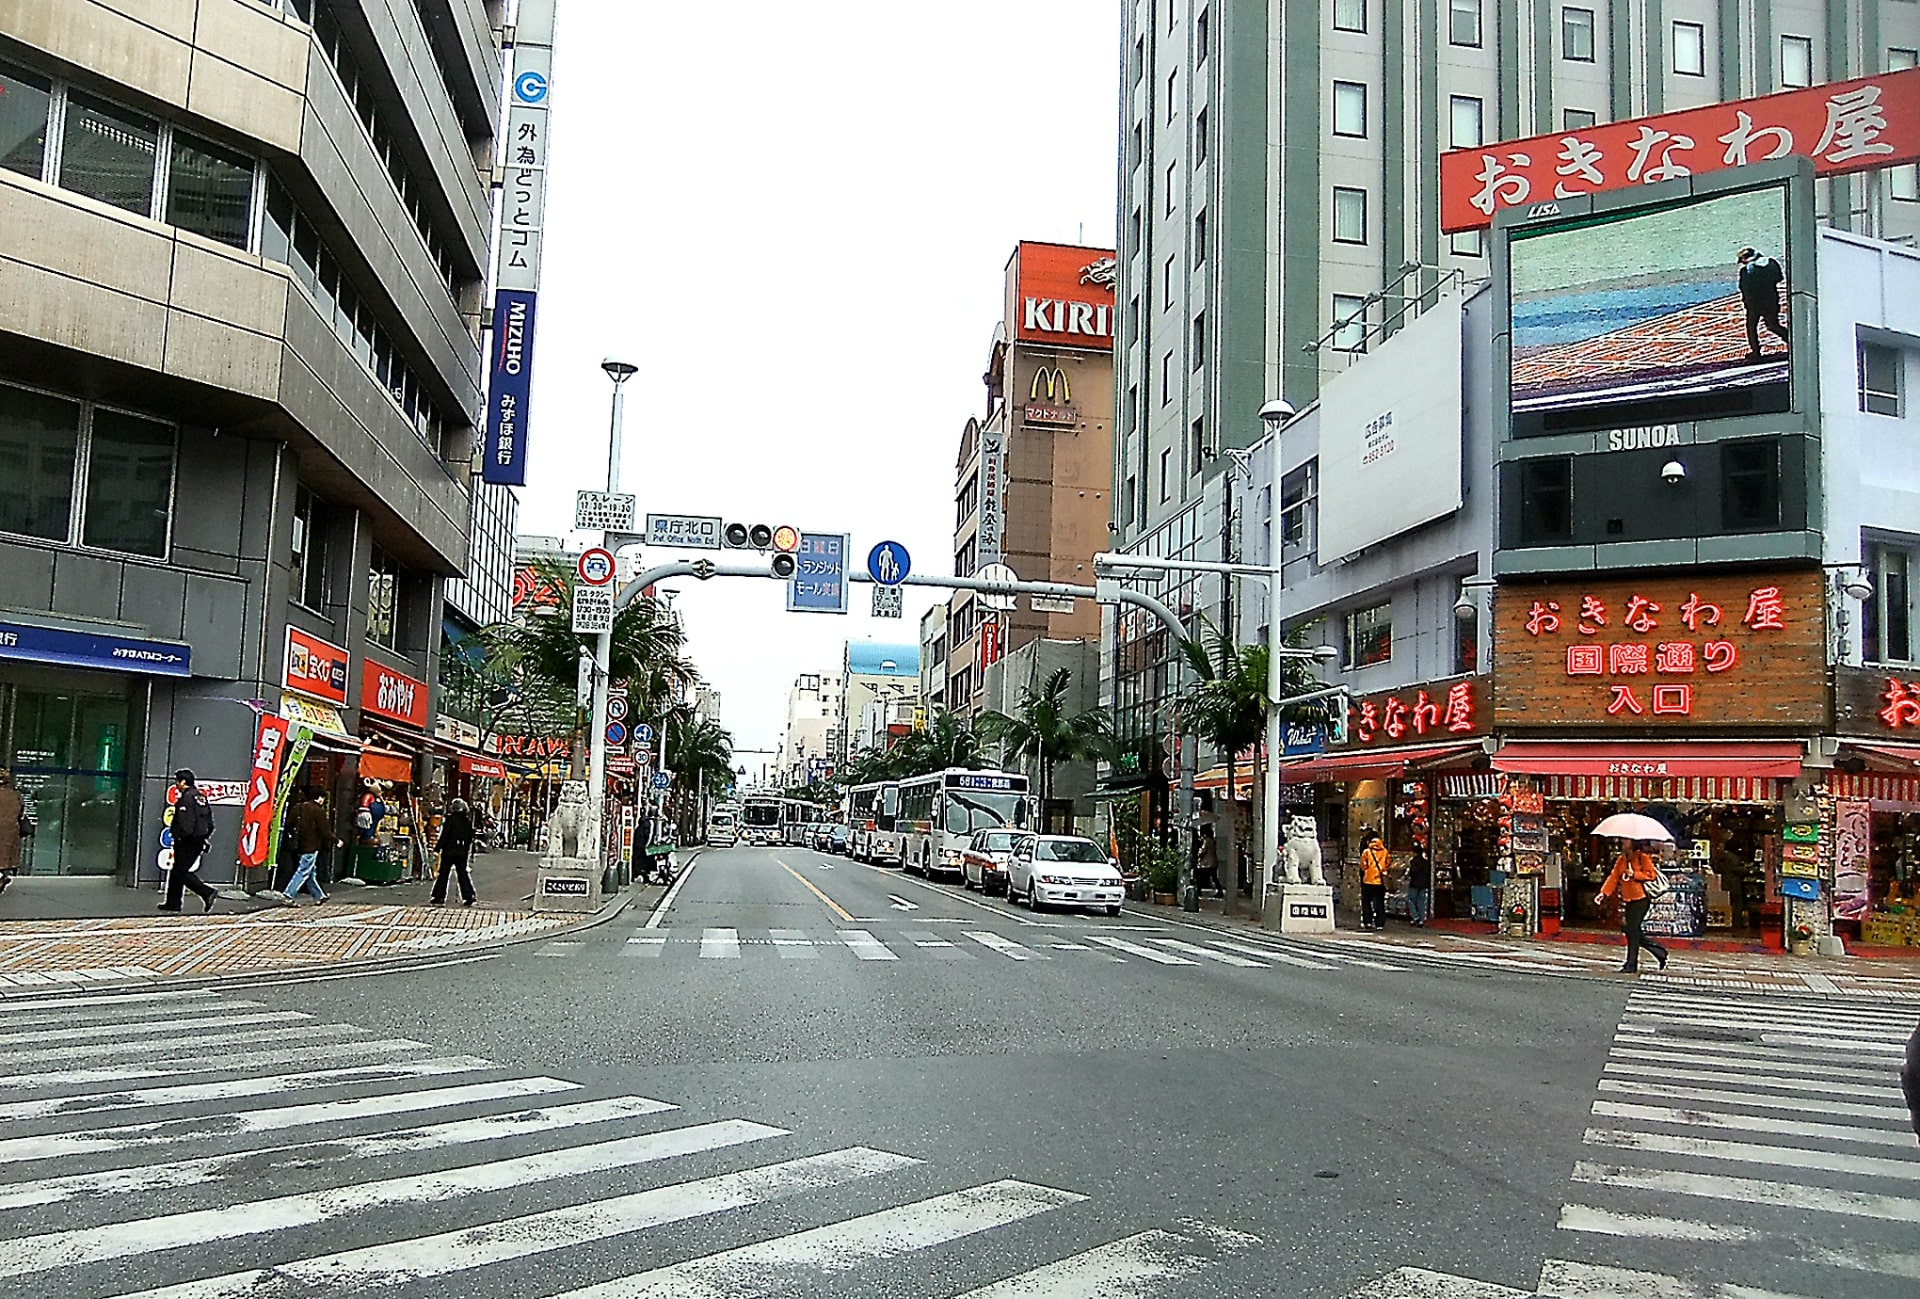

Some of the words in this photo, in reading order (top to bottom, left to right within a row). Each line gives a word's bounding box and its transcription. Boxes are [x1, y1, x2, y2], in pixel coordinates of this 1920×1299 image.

[1469, 84, 1896, 216] おきなわ屋
[1527, 202, 1561, 218] LISA
[1024, 297, 1116, 337] KIRI
[505, 301, 527, 376] MIZUHO
[497, 394, 517, 466] みずほ銀行
[1608, 424, 1681, 452] SUNOA
[578, 493, 633, 504] バスレーン
[654, 519, 713, 535] 県庁北口
[800, 539, 839, 555] 日曜日
[796, 560, 842, 576] トランジット
[1525, 586, 1787, 636] おきなわ屋
[308, 653, 331, 682] 宝くじ
[1566, 641, 1738, 675] 国際通り
[377, 672, 415, 718] おみやげ
[1607, 684, 1691, 714] 入口
[1347, 681, 1475, 742] きなわ屋
[637, 753, 647, 762] 30
[1608, 762, 1668, 774] おきなわ屋
